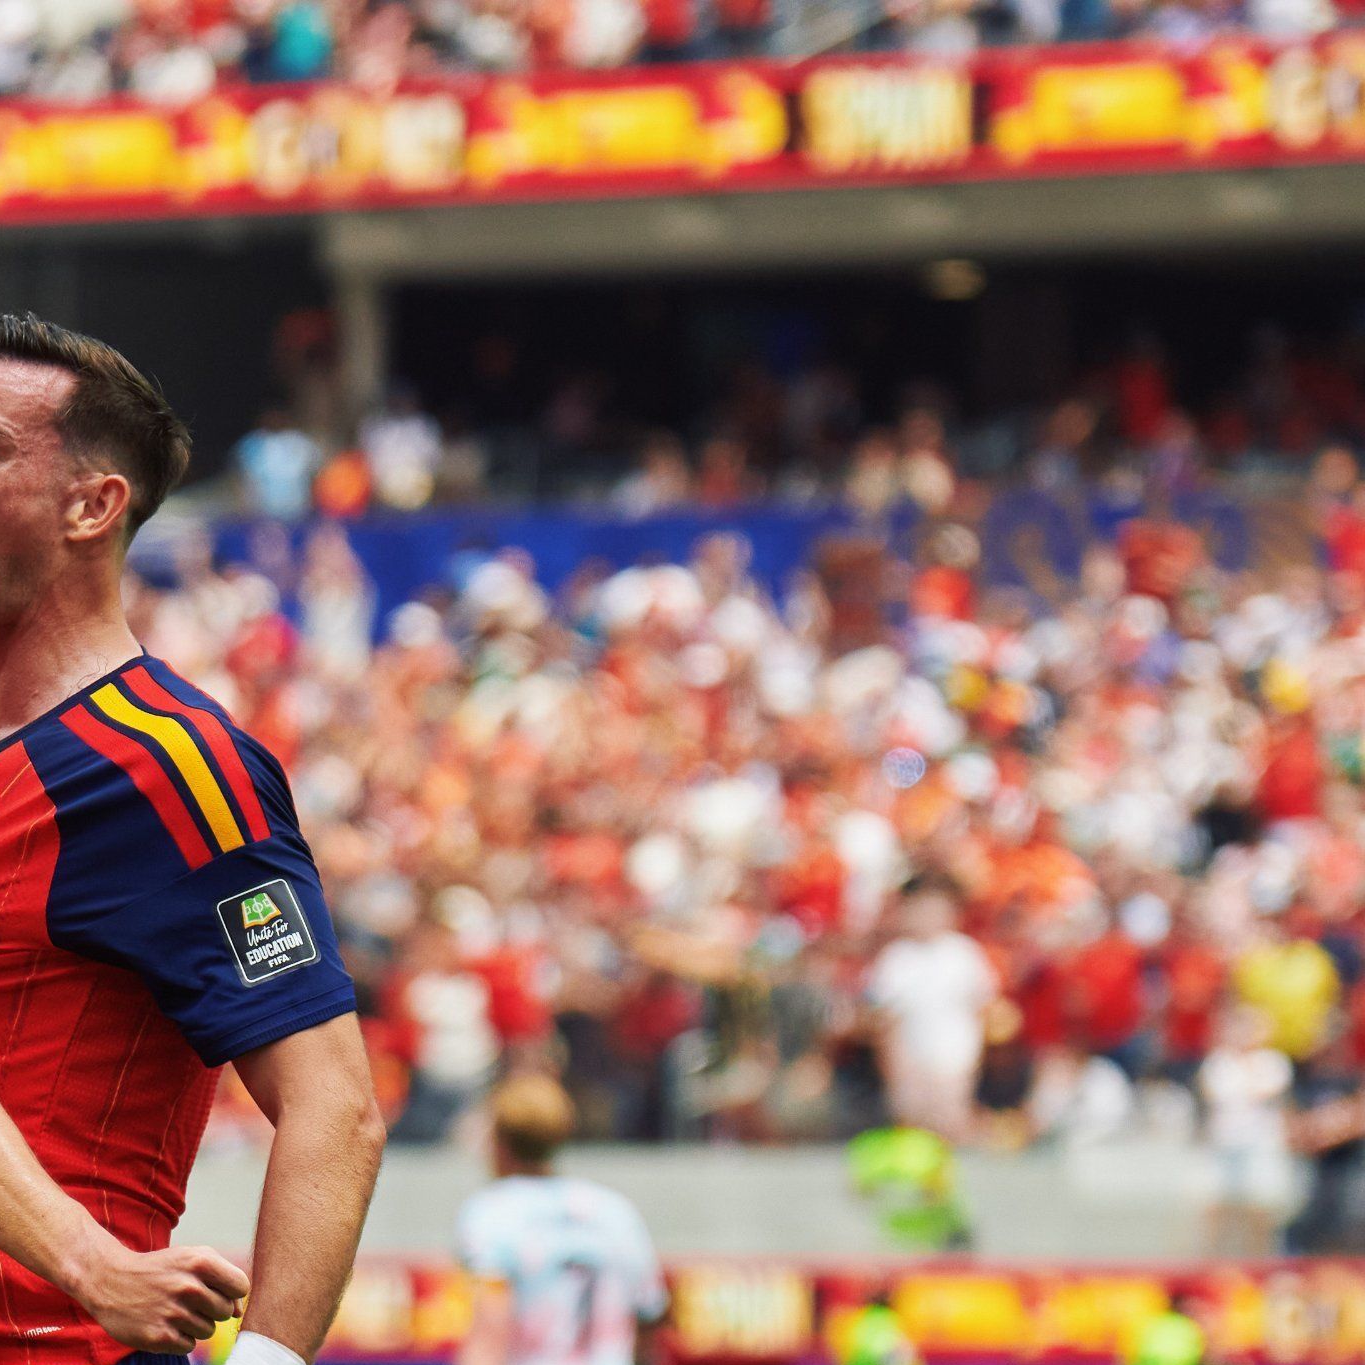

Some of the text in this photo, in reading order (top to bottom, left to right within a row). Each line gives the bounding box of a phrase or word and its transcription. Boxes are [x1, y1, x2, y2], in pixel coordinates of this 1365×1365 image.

[246, 918, 289, 947] Unite For
[245, 931, 304, 966] EDUCATION
[268, 953, 290, 968] FIFA
